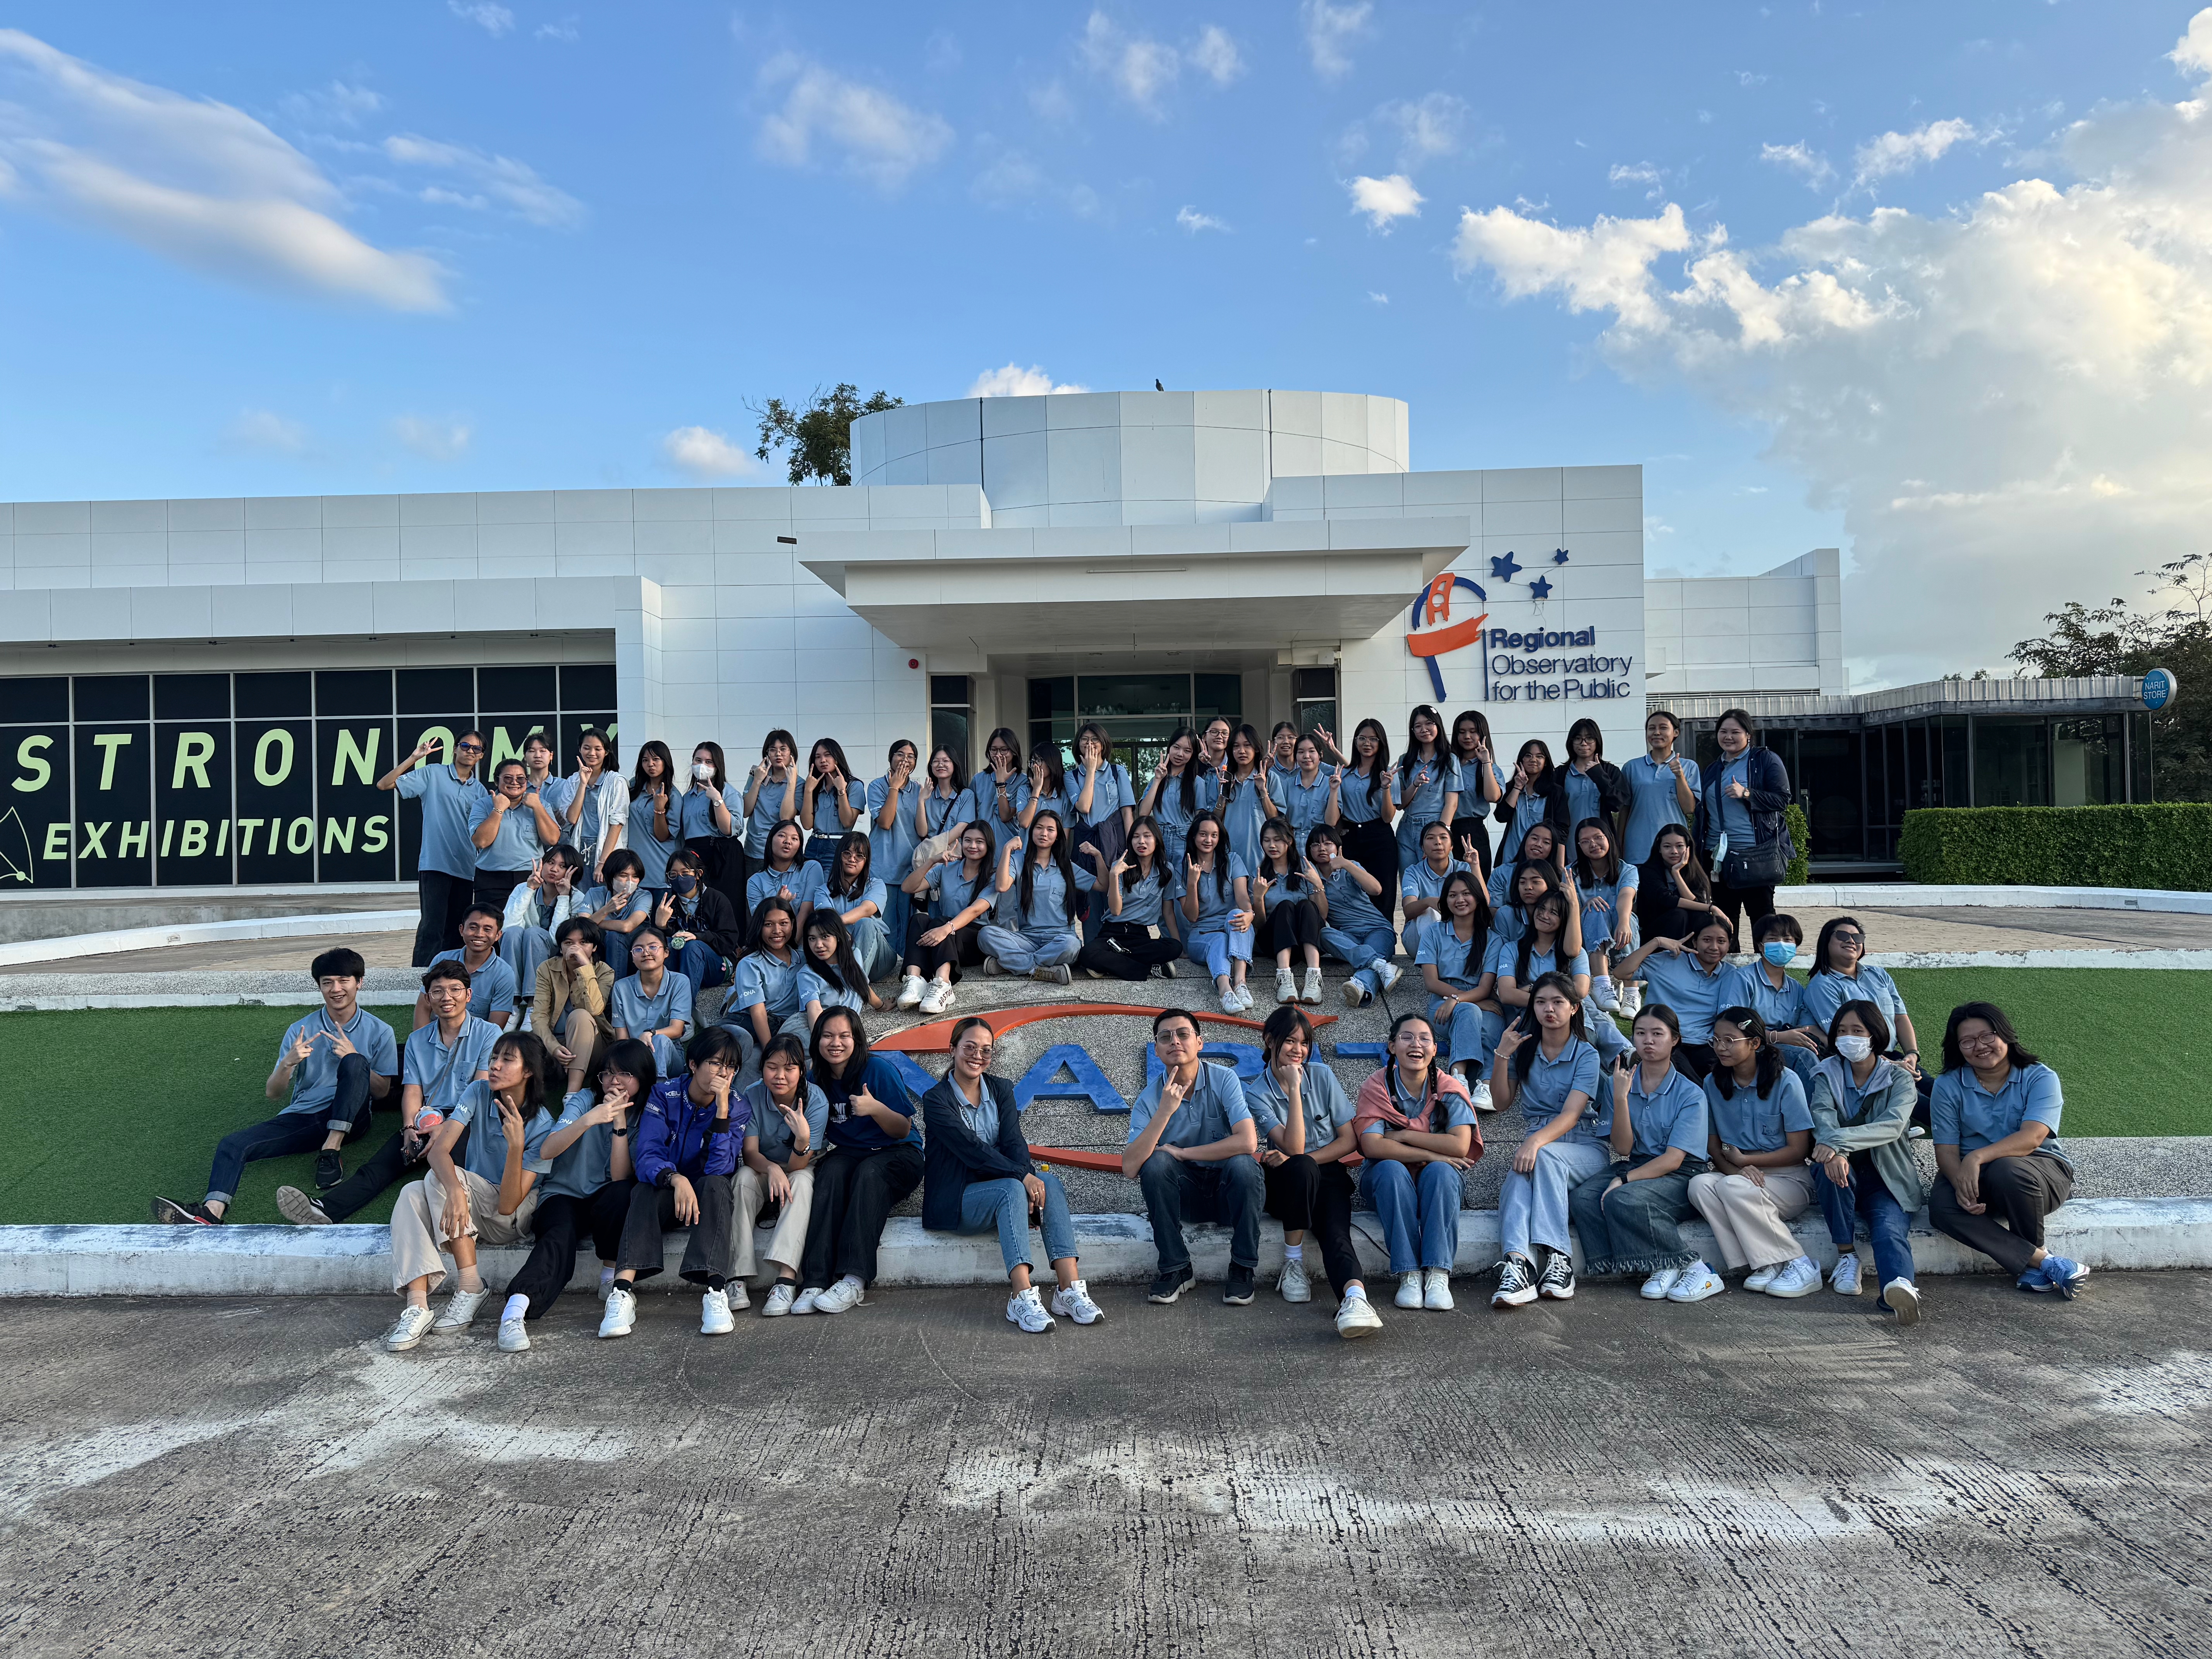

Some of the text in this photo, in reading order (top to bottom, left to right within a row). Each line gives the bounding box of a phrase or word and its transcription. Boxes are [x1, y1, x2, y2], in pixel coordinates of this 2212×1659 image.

[1491, 626, 1595, 653] Regional
[1492, 654, 1632, 676] Observatory
[1492, 678, 1630, 700] for the Public
[2143, 690, 2166, 699] STORE
[2145, 680, 2165, 690] NARIT
[43, 815, 389, 860] EXHIBITIONS
